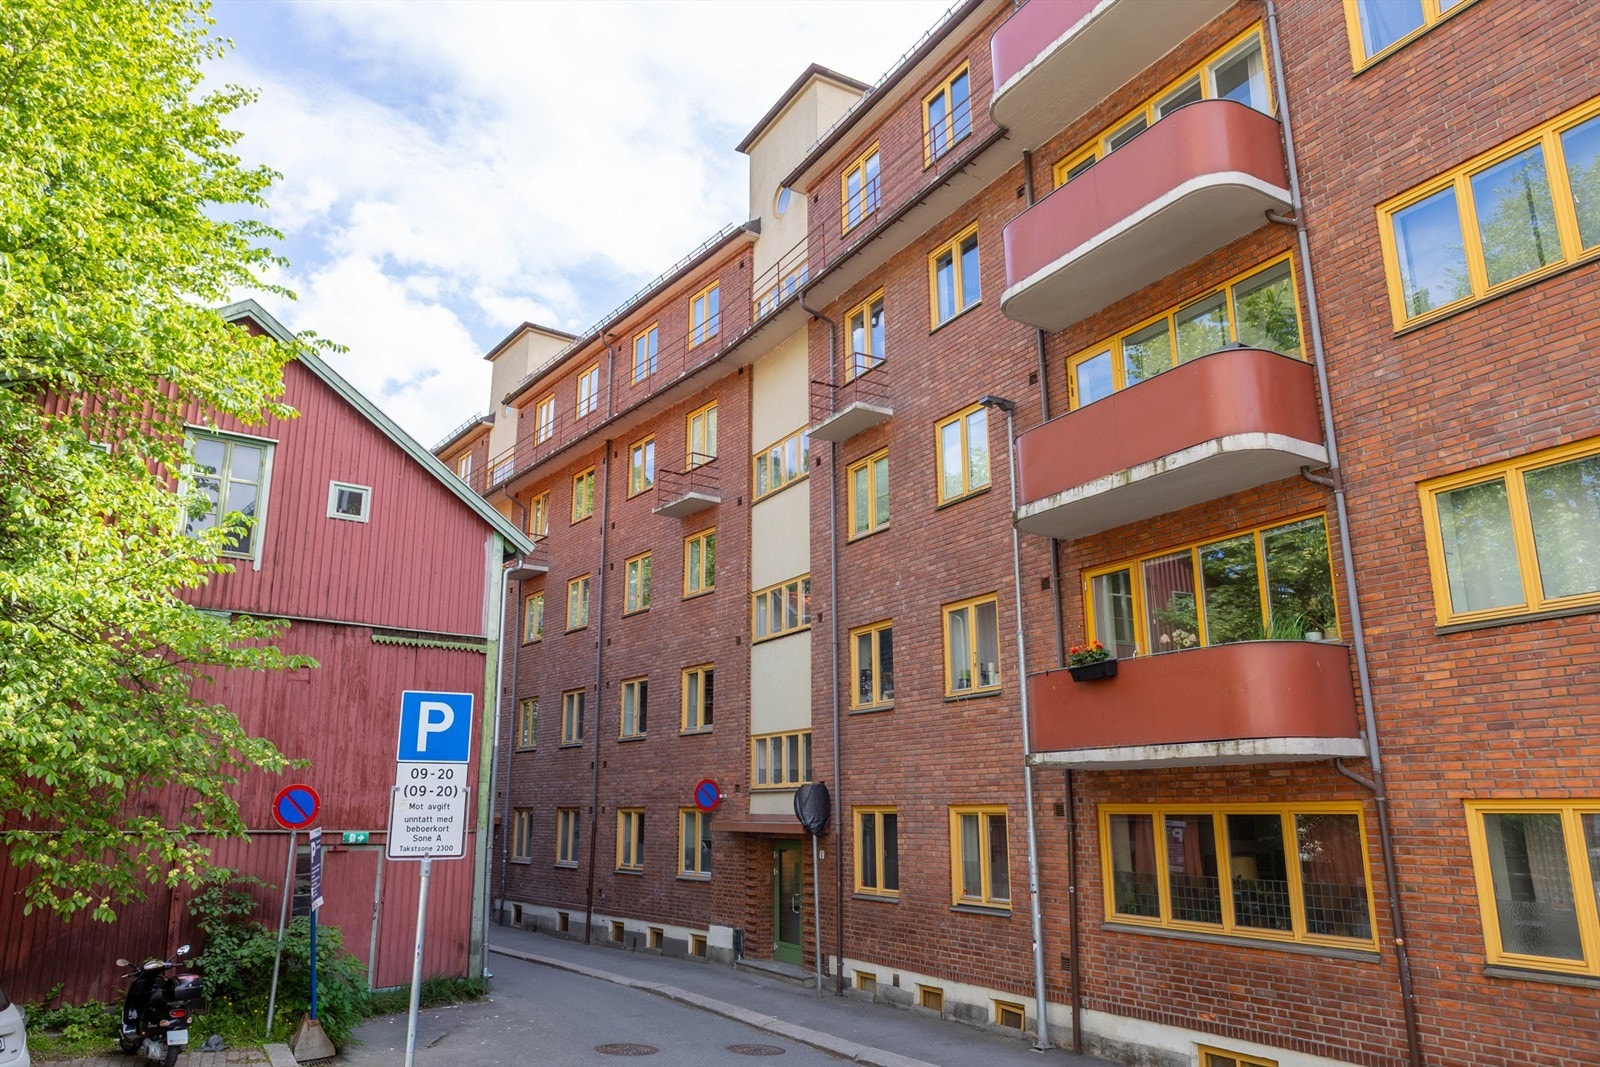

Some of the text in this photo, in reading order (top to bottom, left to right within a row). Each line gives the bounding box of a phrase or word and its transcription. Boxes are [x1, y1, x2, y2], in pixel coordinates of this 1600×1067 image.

[416, 701, 455, 752] P
[408, 802, 451, 812] Mot avgift
[404, 815, 454, 823] unntatt med
[406, 825, 450, 833] beboerkort
[412, 834, 442, 842] Sone A
[436, 844, 454, 852] 2300
